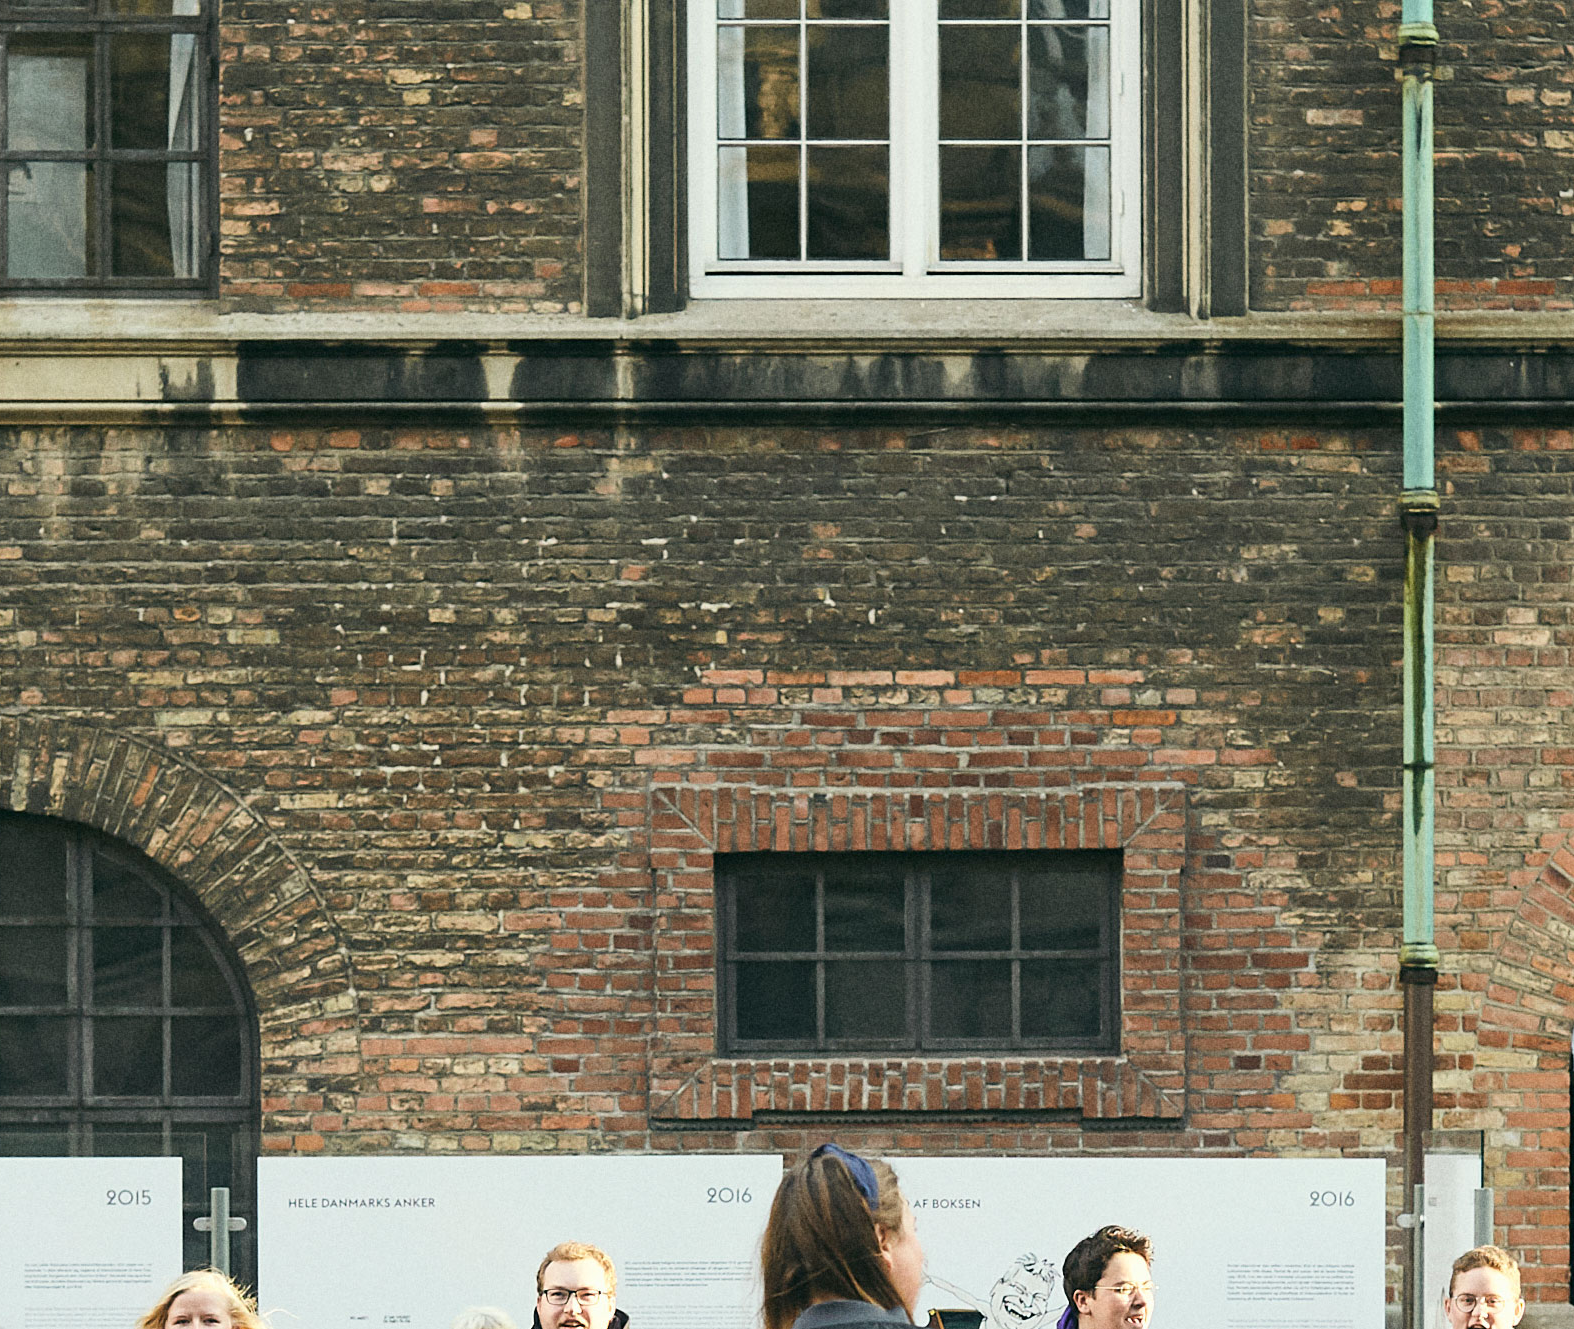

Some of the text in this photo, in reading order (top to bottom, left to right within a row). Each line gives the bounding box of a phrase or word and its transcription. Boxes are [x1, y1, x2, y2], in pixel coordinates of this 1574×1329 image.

[106, 1189, 153, 1206] 2015
[288, 1197, 436, 1208] HELE DANMARKS ANKER
[706, 1187, 753, 1204] 2016
[913, 1199, 981, 1209] AF BOKSEN
[1309, 1190, 1356, 1207] 2016
